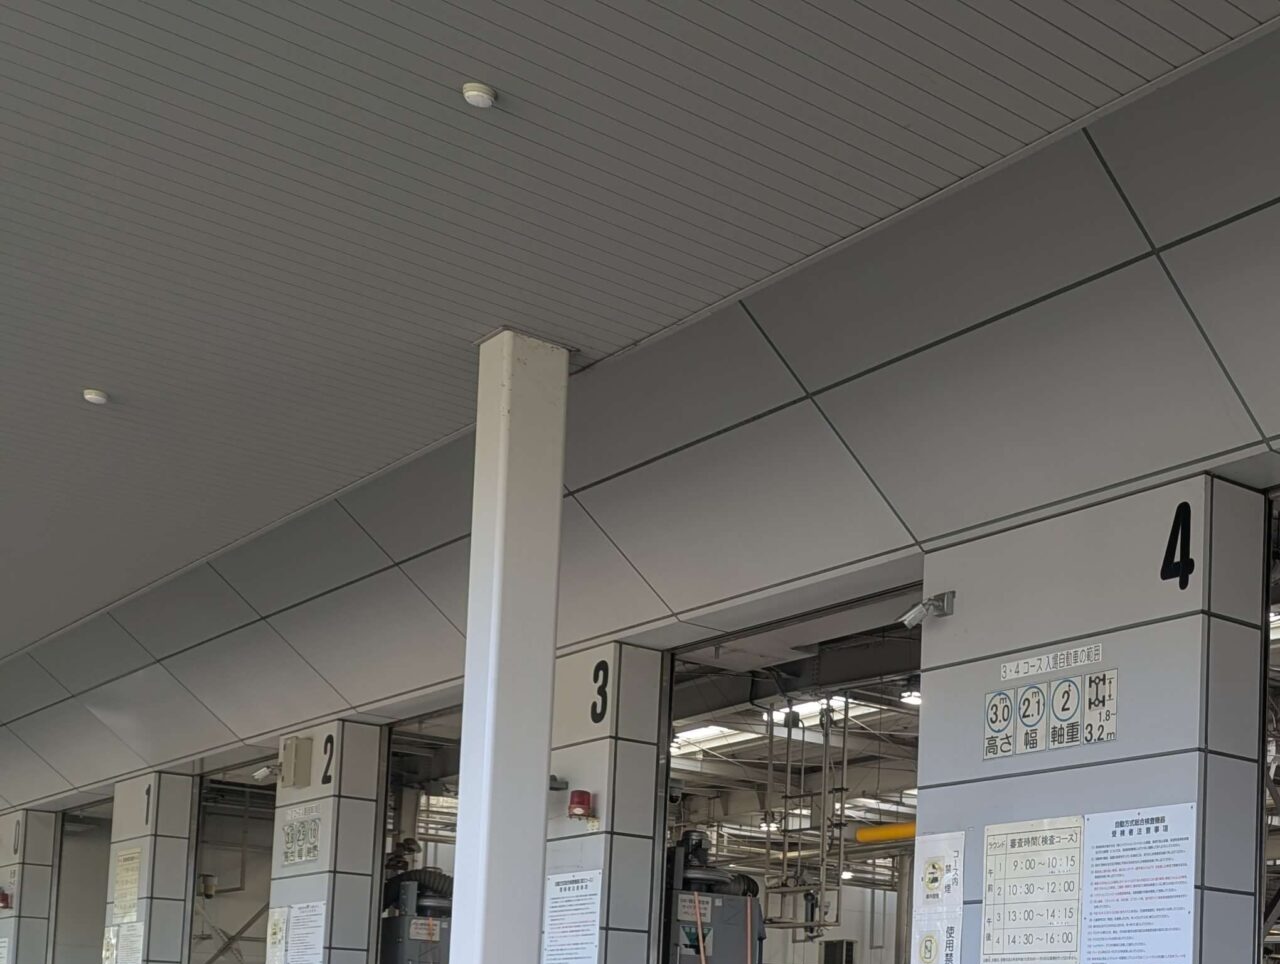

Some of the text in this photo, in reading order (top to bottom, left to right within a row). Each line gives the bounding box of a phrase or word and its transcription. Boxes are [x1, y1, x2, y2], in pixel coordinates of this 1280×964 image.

[1160, 501, 1195, 590] 4
[590, 660, 609, 723] 3
[1061, 690, 1071, 712] 2
[990, 704, 1010, 724] 3.0
[1022, 698, 1040, 719] 2.1
[985, 733, 1013, 756] 高さ
[1024, 728, 1039, 749] 幅
[1051, 721, 1080, 745] 軸重
[322, 734, 334, 785] 2
[145, 784, 151, 825] 1
